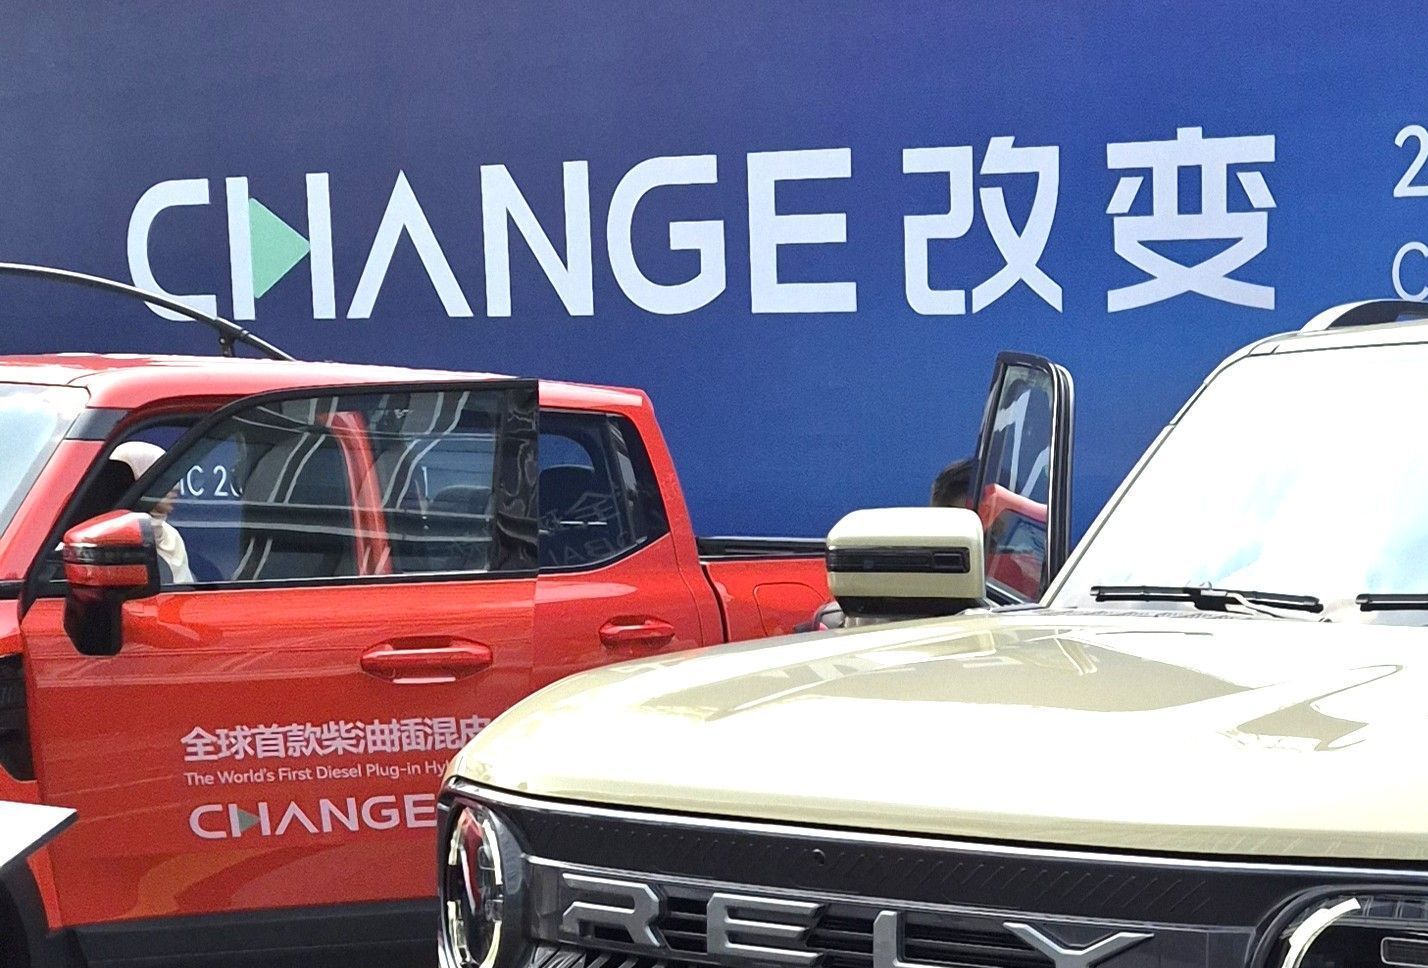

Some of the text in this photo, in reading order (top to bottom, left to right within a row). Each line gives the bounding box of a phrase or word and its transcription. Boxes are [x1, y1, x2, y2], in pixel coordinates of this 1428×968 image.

[126, 126, 1277, 321] CHANGE 改变
[184, 771, 214, 787] The
[217, 767, 275, 784] World's
[278, 766, 313, 781] First
[317, 763, 362, 780] Diesel
[366, 761, 421, 779] Plug-in
[189, 793, 437, 839] CHANGE
